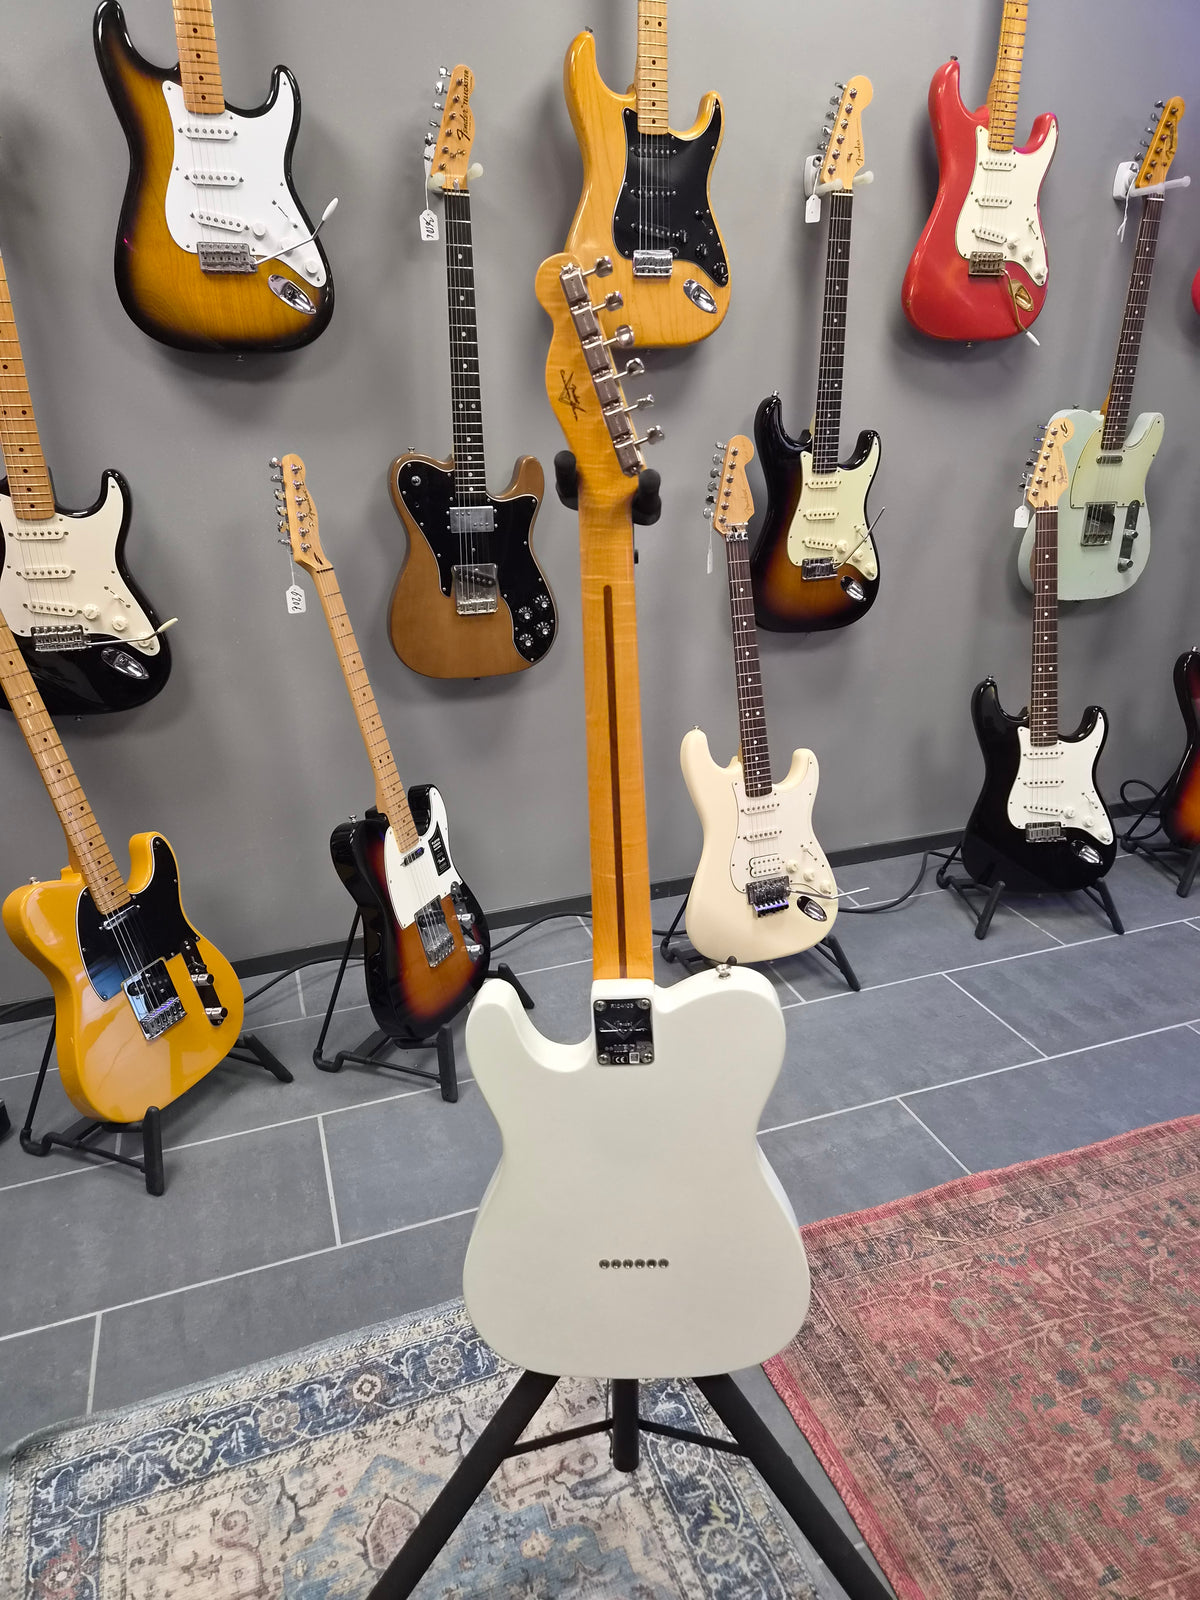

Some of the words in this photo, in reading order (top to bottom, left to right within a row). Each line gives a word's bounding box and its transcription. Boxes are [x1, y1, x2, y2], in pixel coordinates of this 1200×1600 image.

[462, 69, 470, 106] TELECASTER
[456, 108, 471, 142] Fender
[855, 139, 864, 167] Fender
